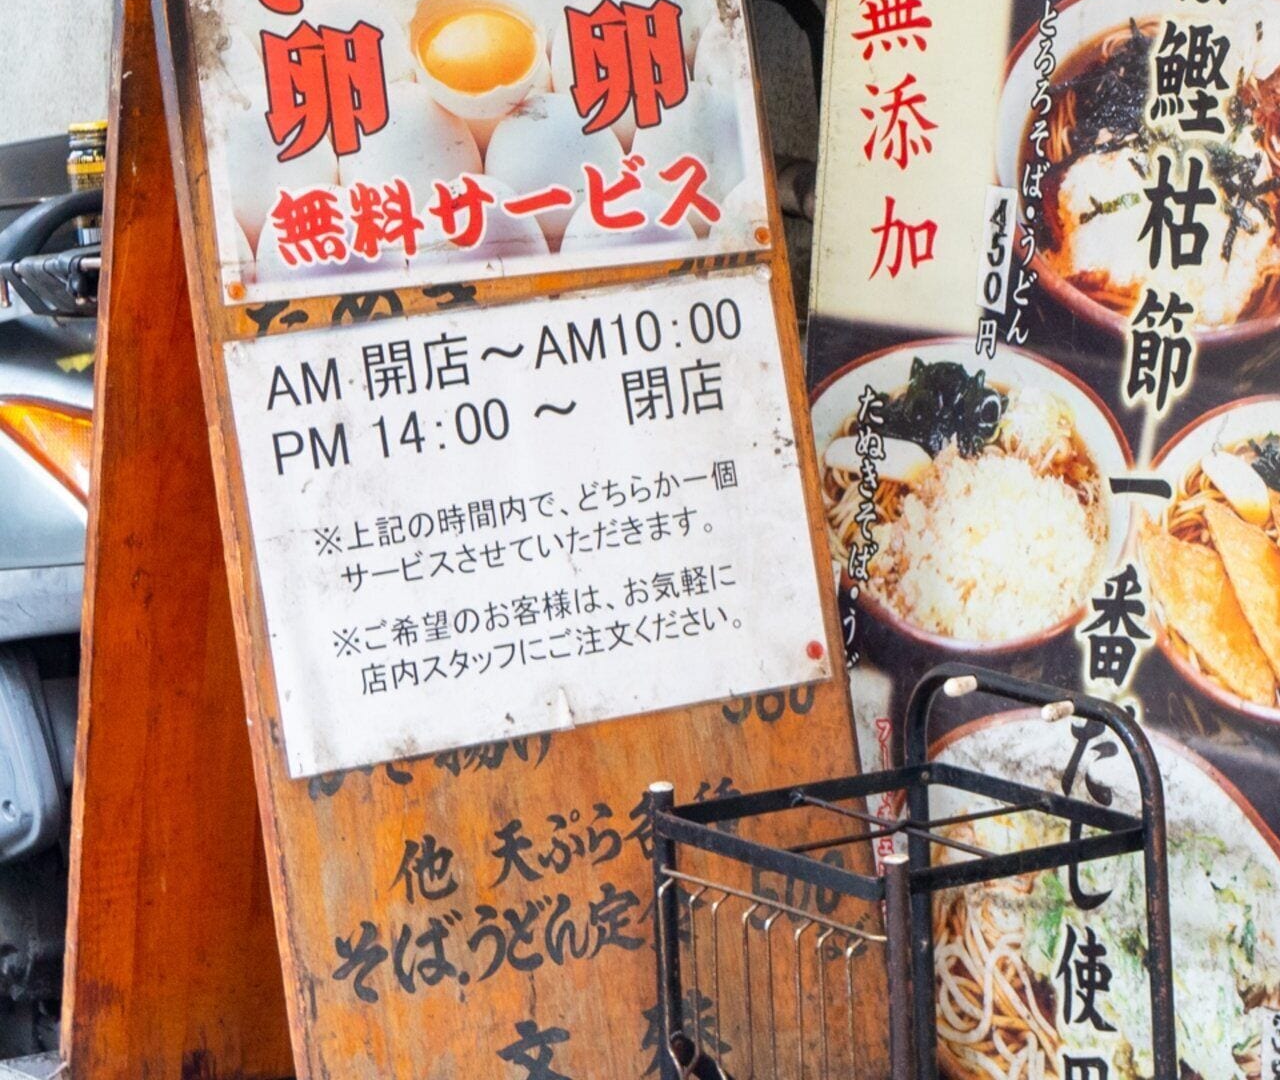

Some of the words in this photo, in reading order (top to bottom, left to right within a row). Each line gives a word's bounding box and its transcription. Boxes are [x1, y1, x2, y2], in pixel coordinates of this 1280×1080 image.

[270, 154, 722, 267] 無料サービス
[266, 357, 343, 411] AM
[271, 423, 351, 476] PM
[372, 397, 511, 462] 14:00
[621, 359, 725, 425] 閉店
[390, 834, 459, 904] 他
